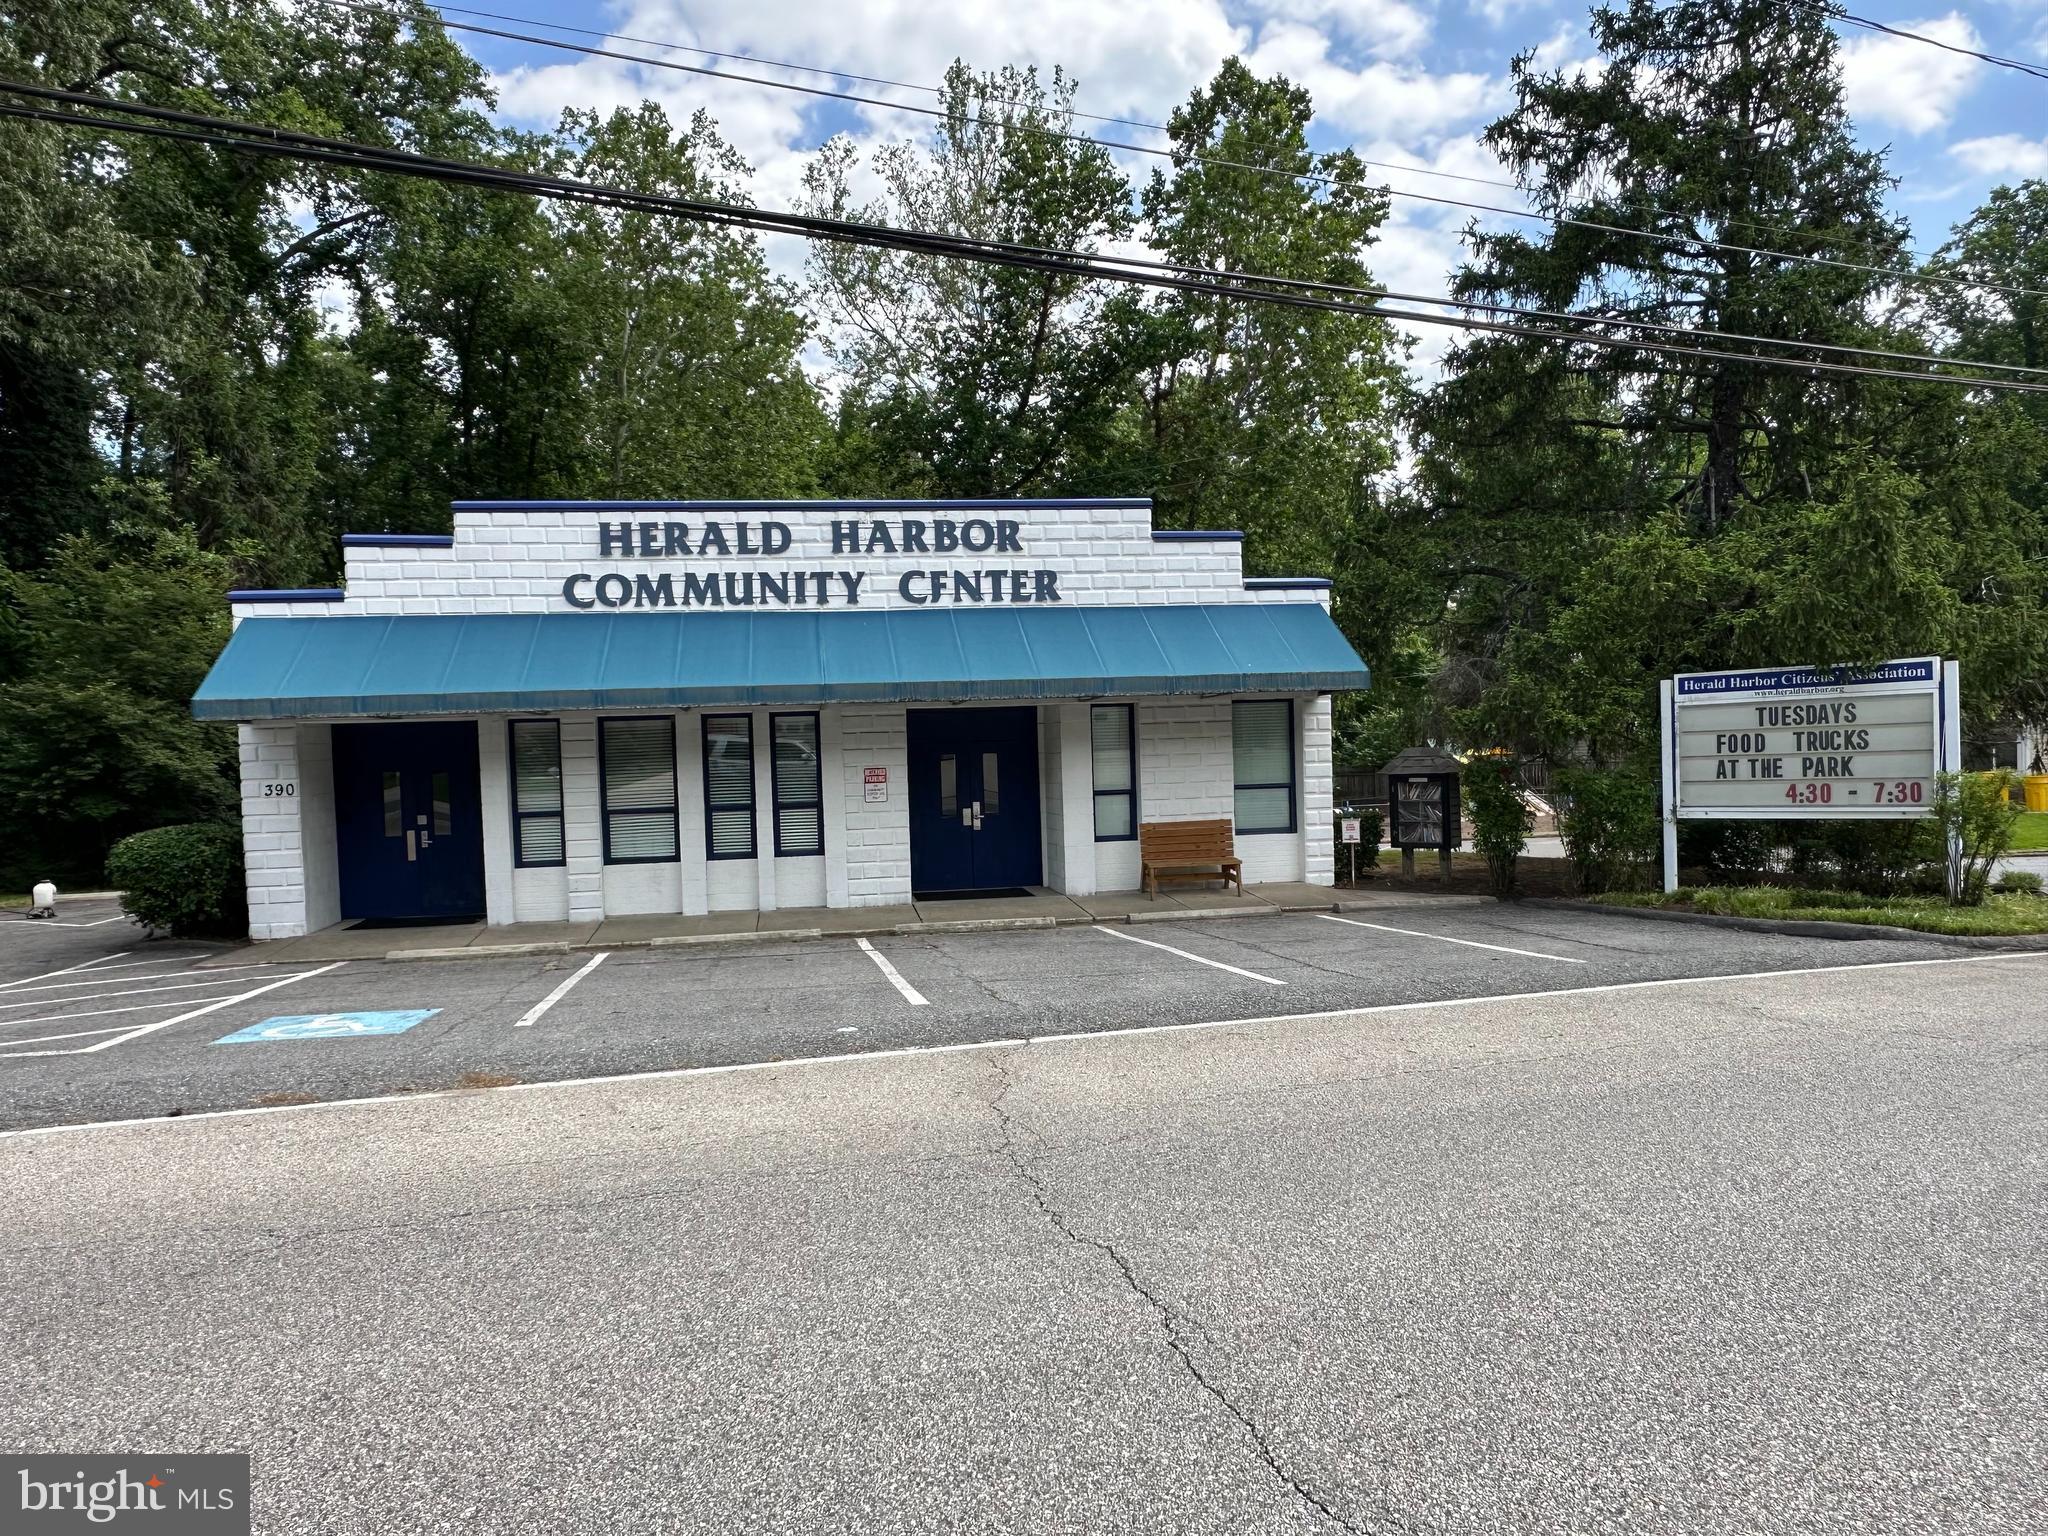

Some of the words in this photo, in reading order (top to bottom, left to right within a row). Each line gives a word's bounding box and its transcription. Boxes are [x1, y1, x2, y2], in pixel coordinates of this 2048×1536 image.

[599, 521, 792, 556] HERALD
[831, 519, 1024, 553] HARBOR
[563, 571, 865, 608] COMMUNITY
[1684, 678, 1726, 691] Herald
[1730, 676, 1777, 688] Harbor
[1755, 703, 1857, 727] TUESDAYS
[1716, 733, 1766, 753] FOOD
[1793, 729, 1870, 752] TRUCKS
[1716, 759, 1739, 779] AT
[1747, 757, 1783, 778] THE
[1802, 756, 1854, 777] PARK
[264, 783, 294, 796] 390
[1785, 783, 1832, 804] 4:30
[1873, 782, 1922, 803] 7:30
